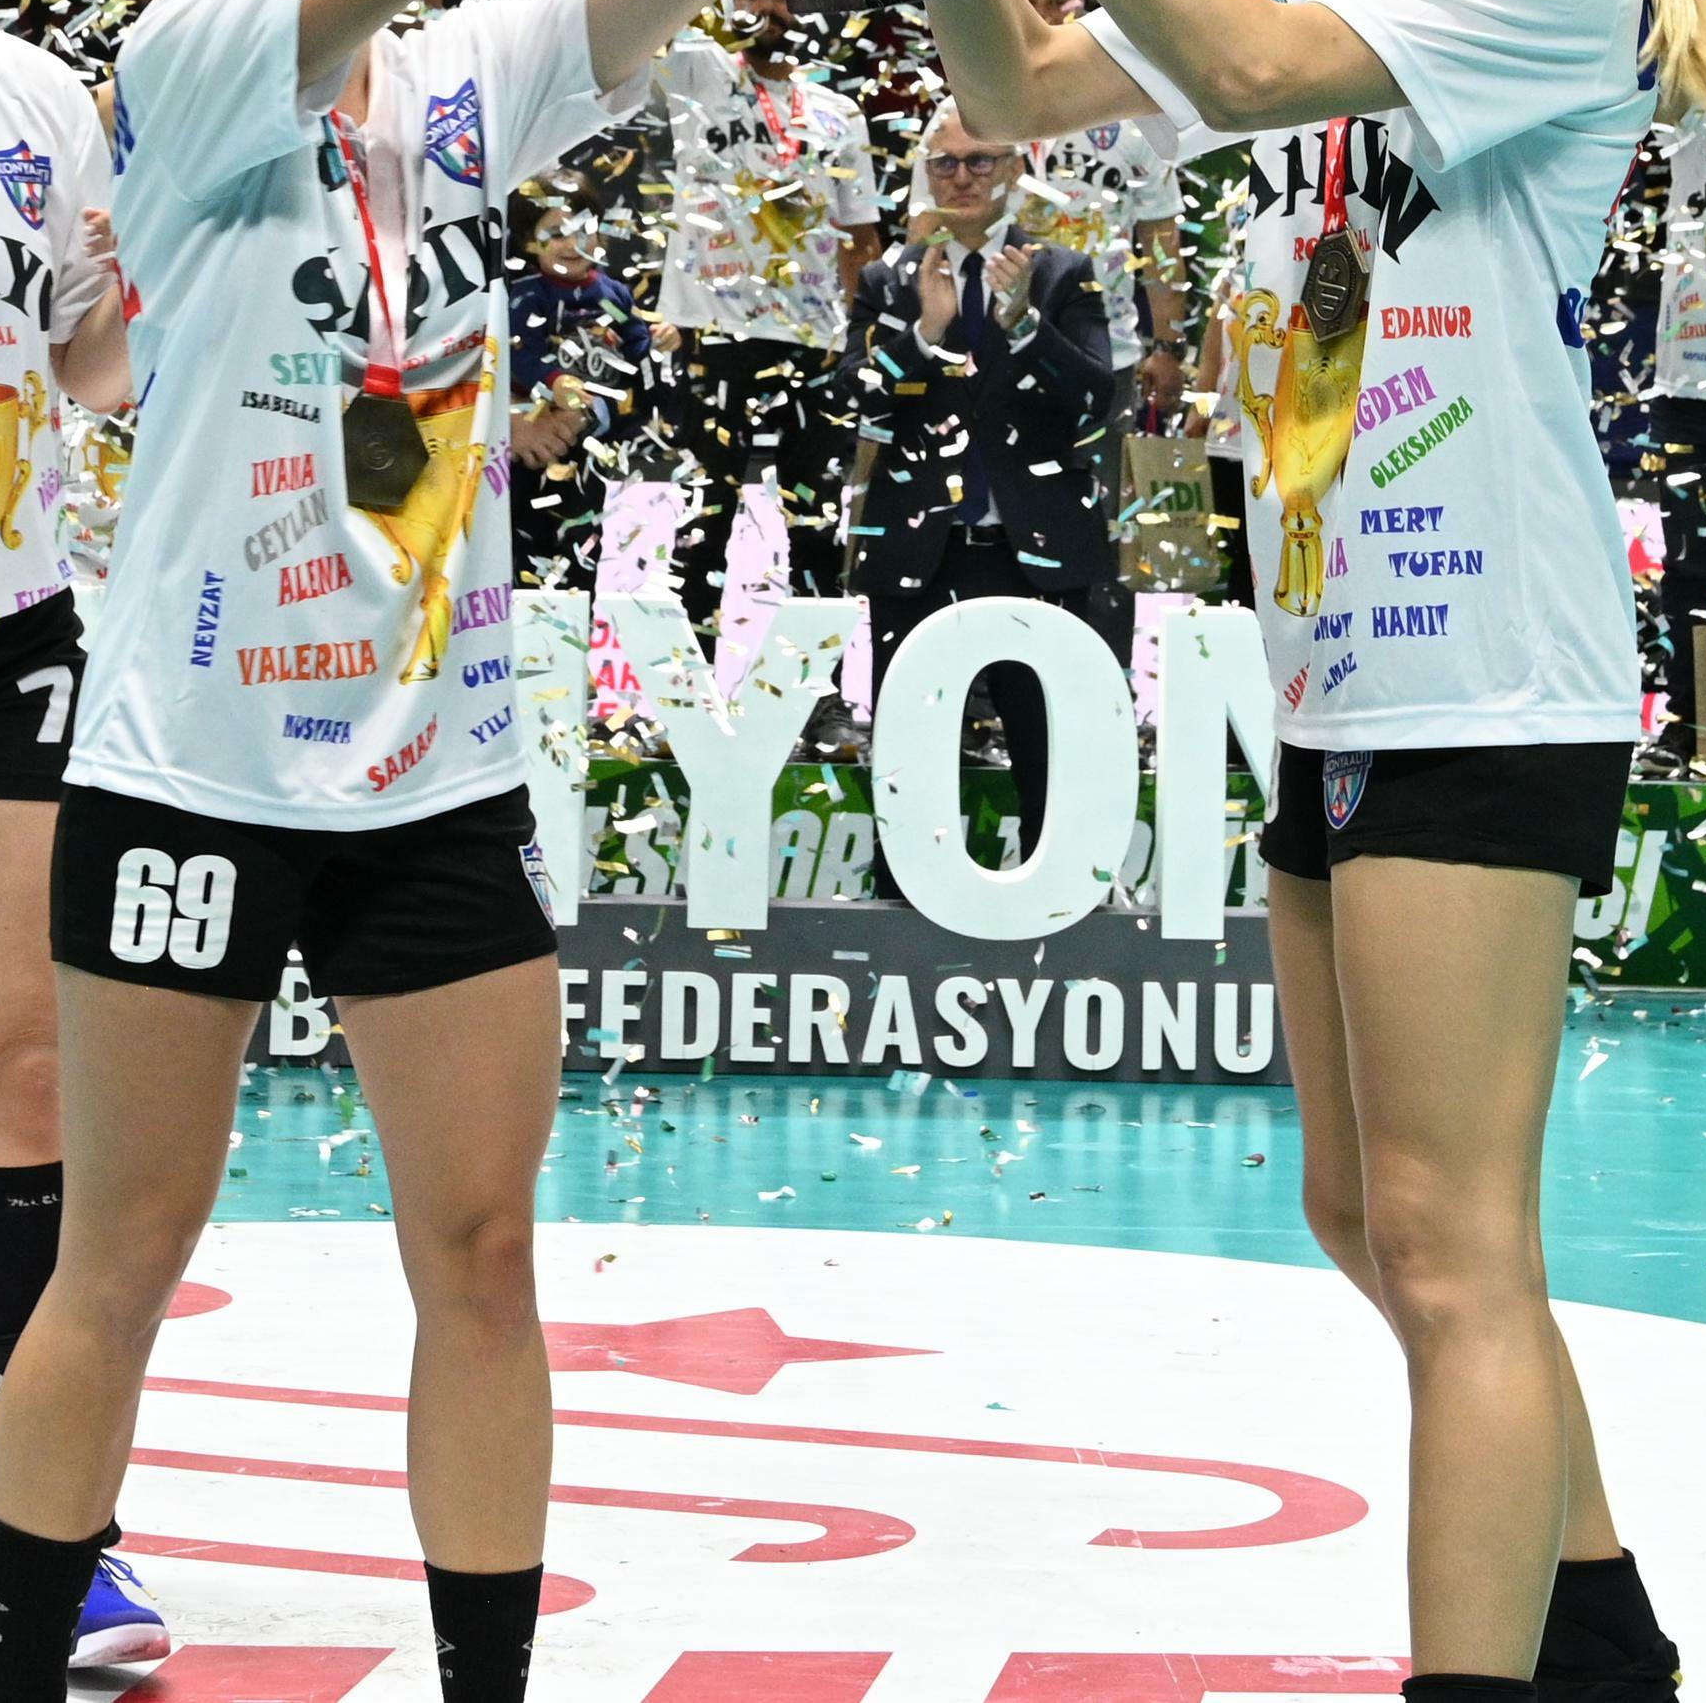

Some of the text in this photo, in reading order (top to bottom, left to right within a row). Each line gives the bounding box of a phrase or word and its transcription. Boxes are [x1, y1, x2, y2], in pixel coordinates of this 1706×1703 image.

[1381, 306, 1472, 339] EDANUR
[1370, 395, 1473, 489] OLEKSANDRA
[1150, 480, 1203, 512] HDI
[1360, 506, 1444, 535] MERT
[245, 488, 330, 572] CEYLAN
[278, 553, 354, 607] ALENA
[1388, 550, 1483, 578] TUFAN
[190, 569, 226, 668] NEVZAT
[1371, 604, 1449, 639] HAMIT
[236, 639, 378, 686] VALERIIA
[16, 665, 74, 743] 7
[109, 847, 238, 970] 69
